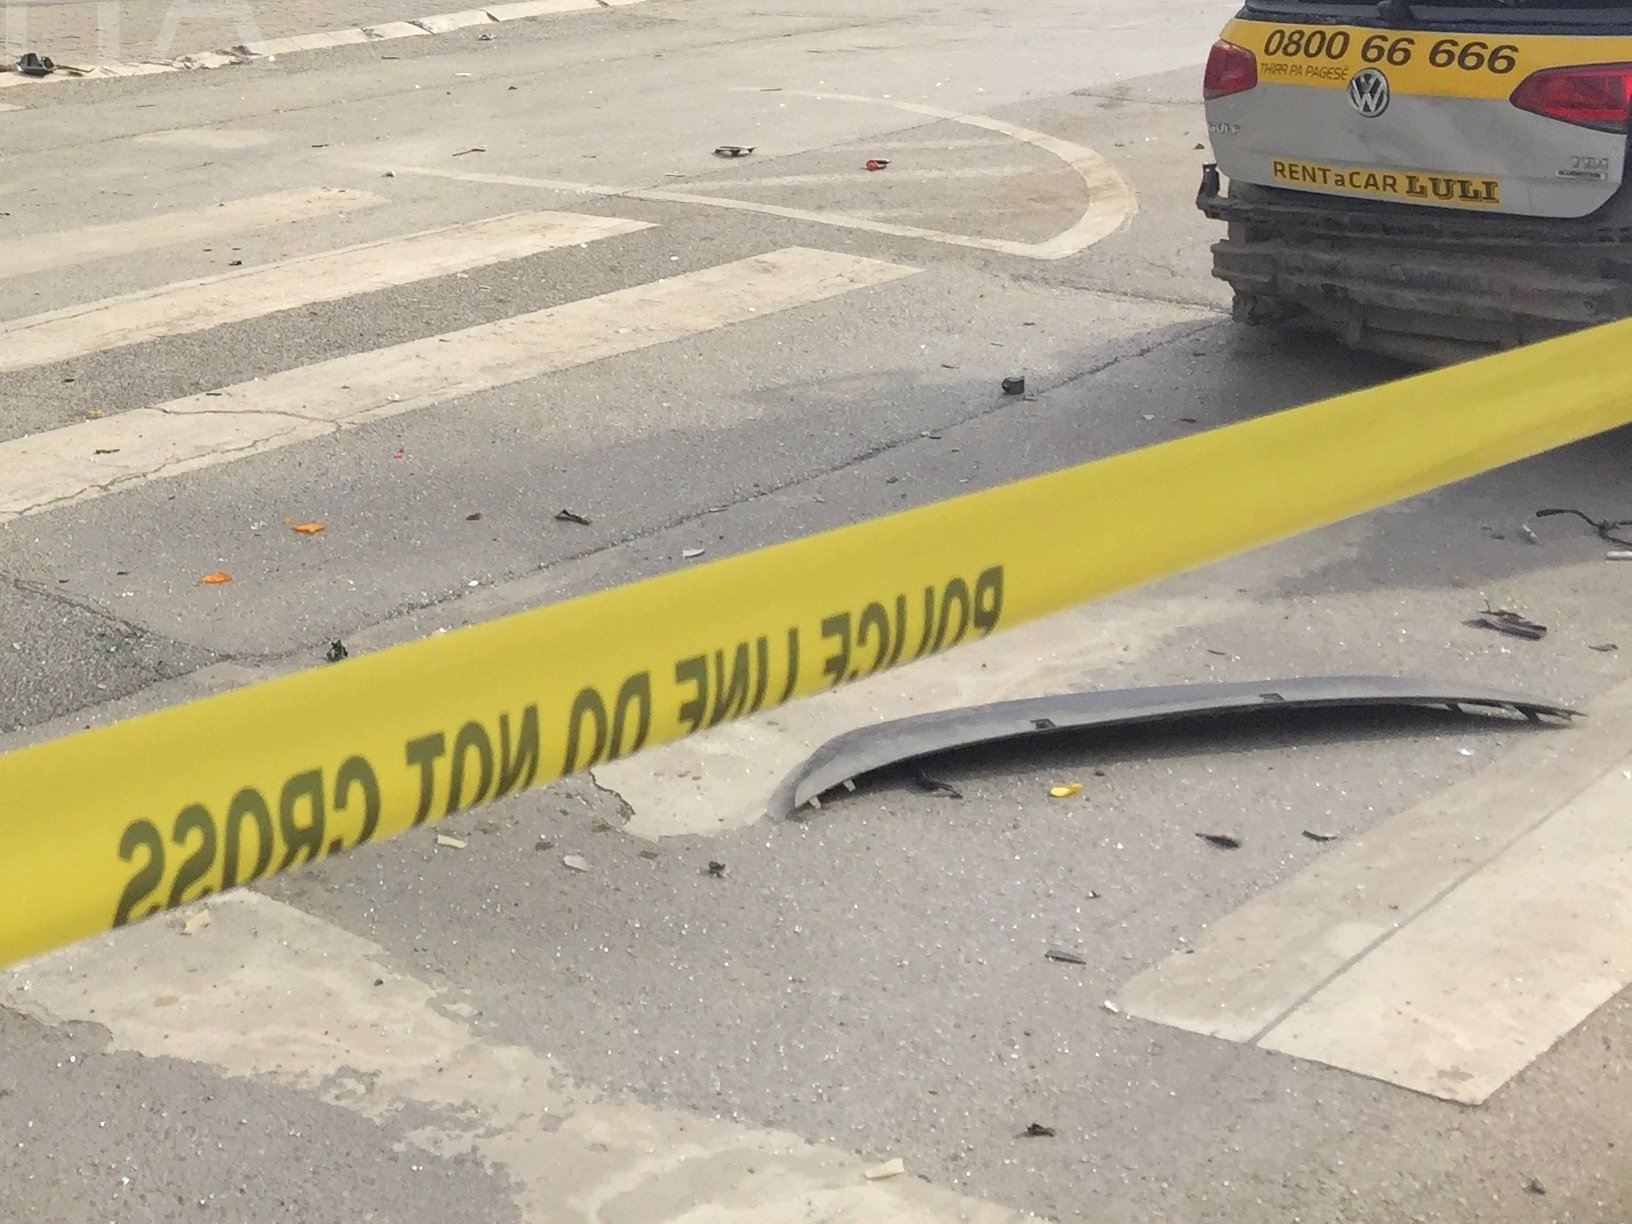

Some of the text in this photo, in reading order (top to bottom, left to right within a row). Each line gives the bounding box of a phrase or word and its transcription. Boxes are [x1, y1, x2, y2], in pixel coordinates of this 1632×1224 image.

[1264, 29, 1520, 74] 0800 66 666
[1405, 175, 1500, 204] LULI
